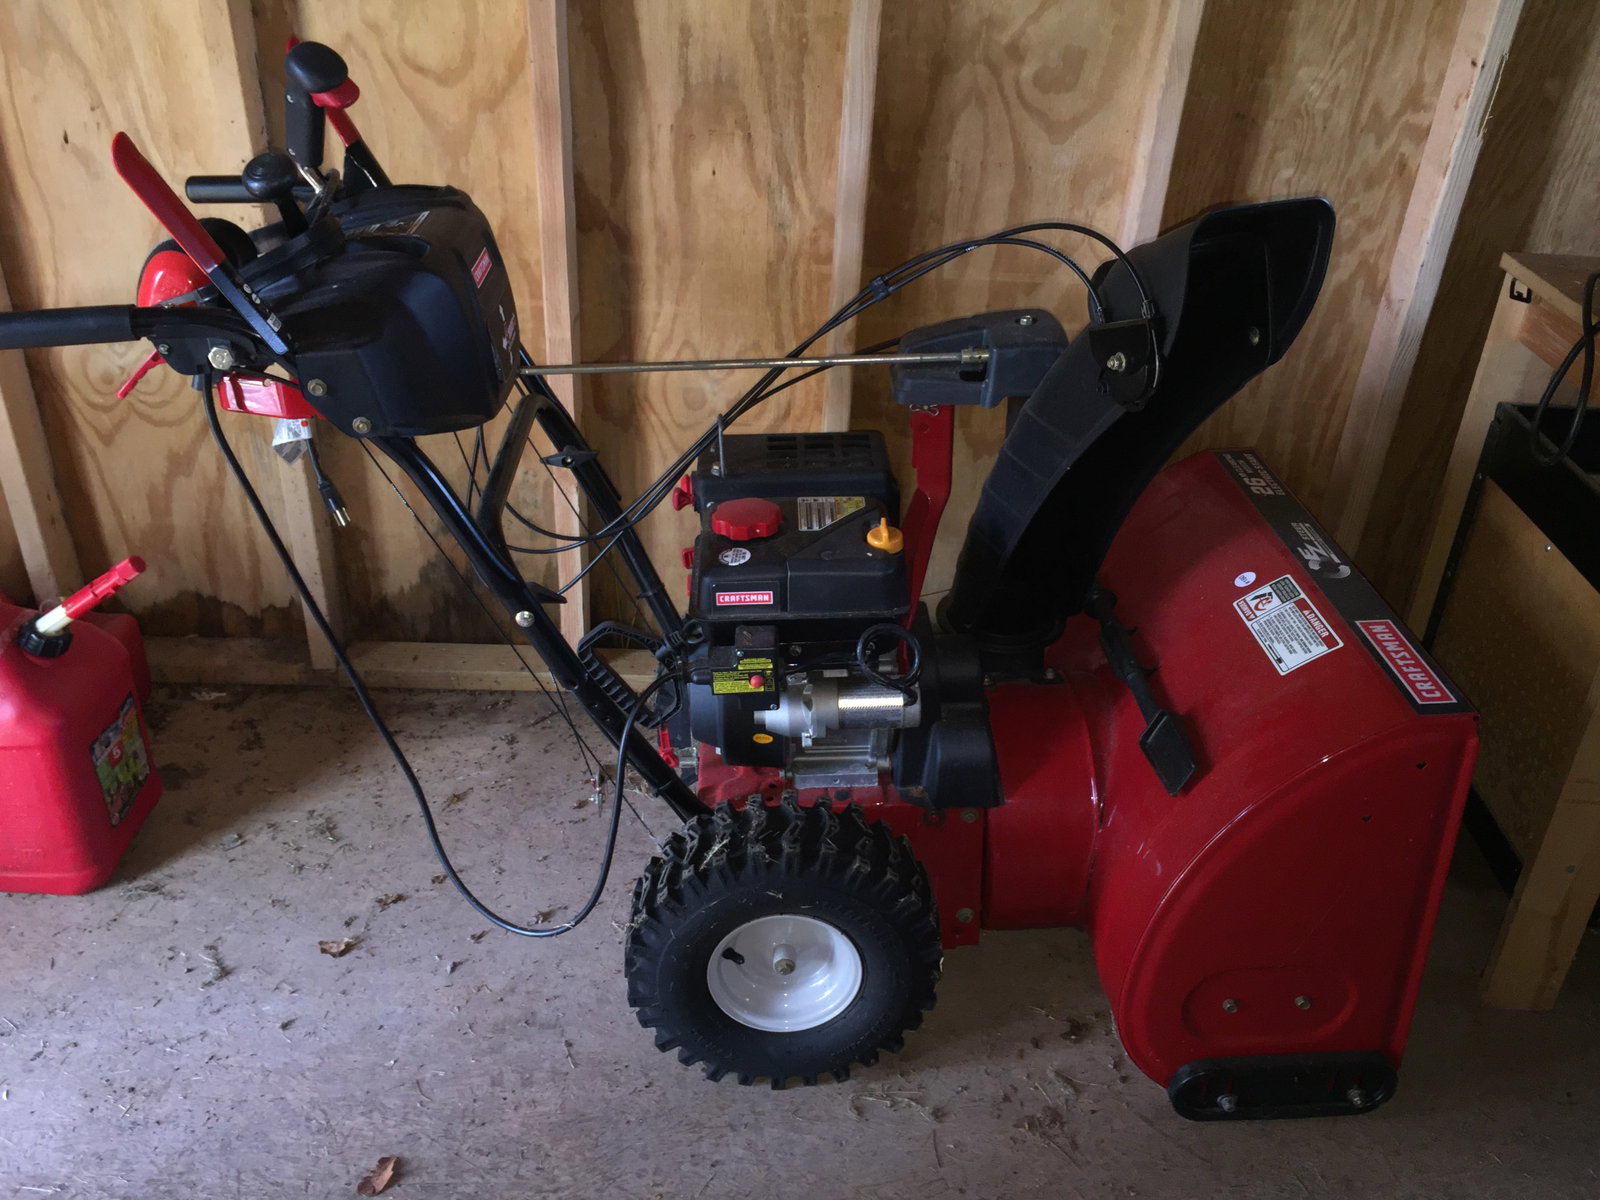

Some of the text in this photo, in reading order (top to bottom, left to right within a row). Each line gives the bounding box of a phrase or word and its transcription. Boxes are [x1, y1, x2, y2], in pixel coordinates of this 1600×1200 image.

[1243, 477, 1275, 495] 26
[719, 594, 770, 603] CRAFTSMAN
[1307, 613, 1330, 638] DANGER
[1369, 624, 1442, 699] CRAFTSMAN
